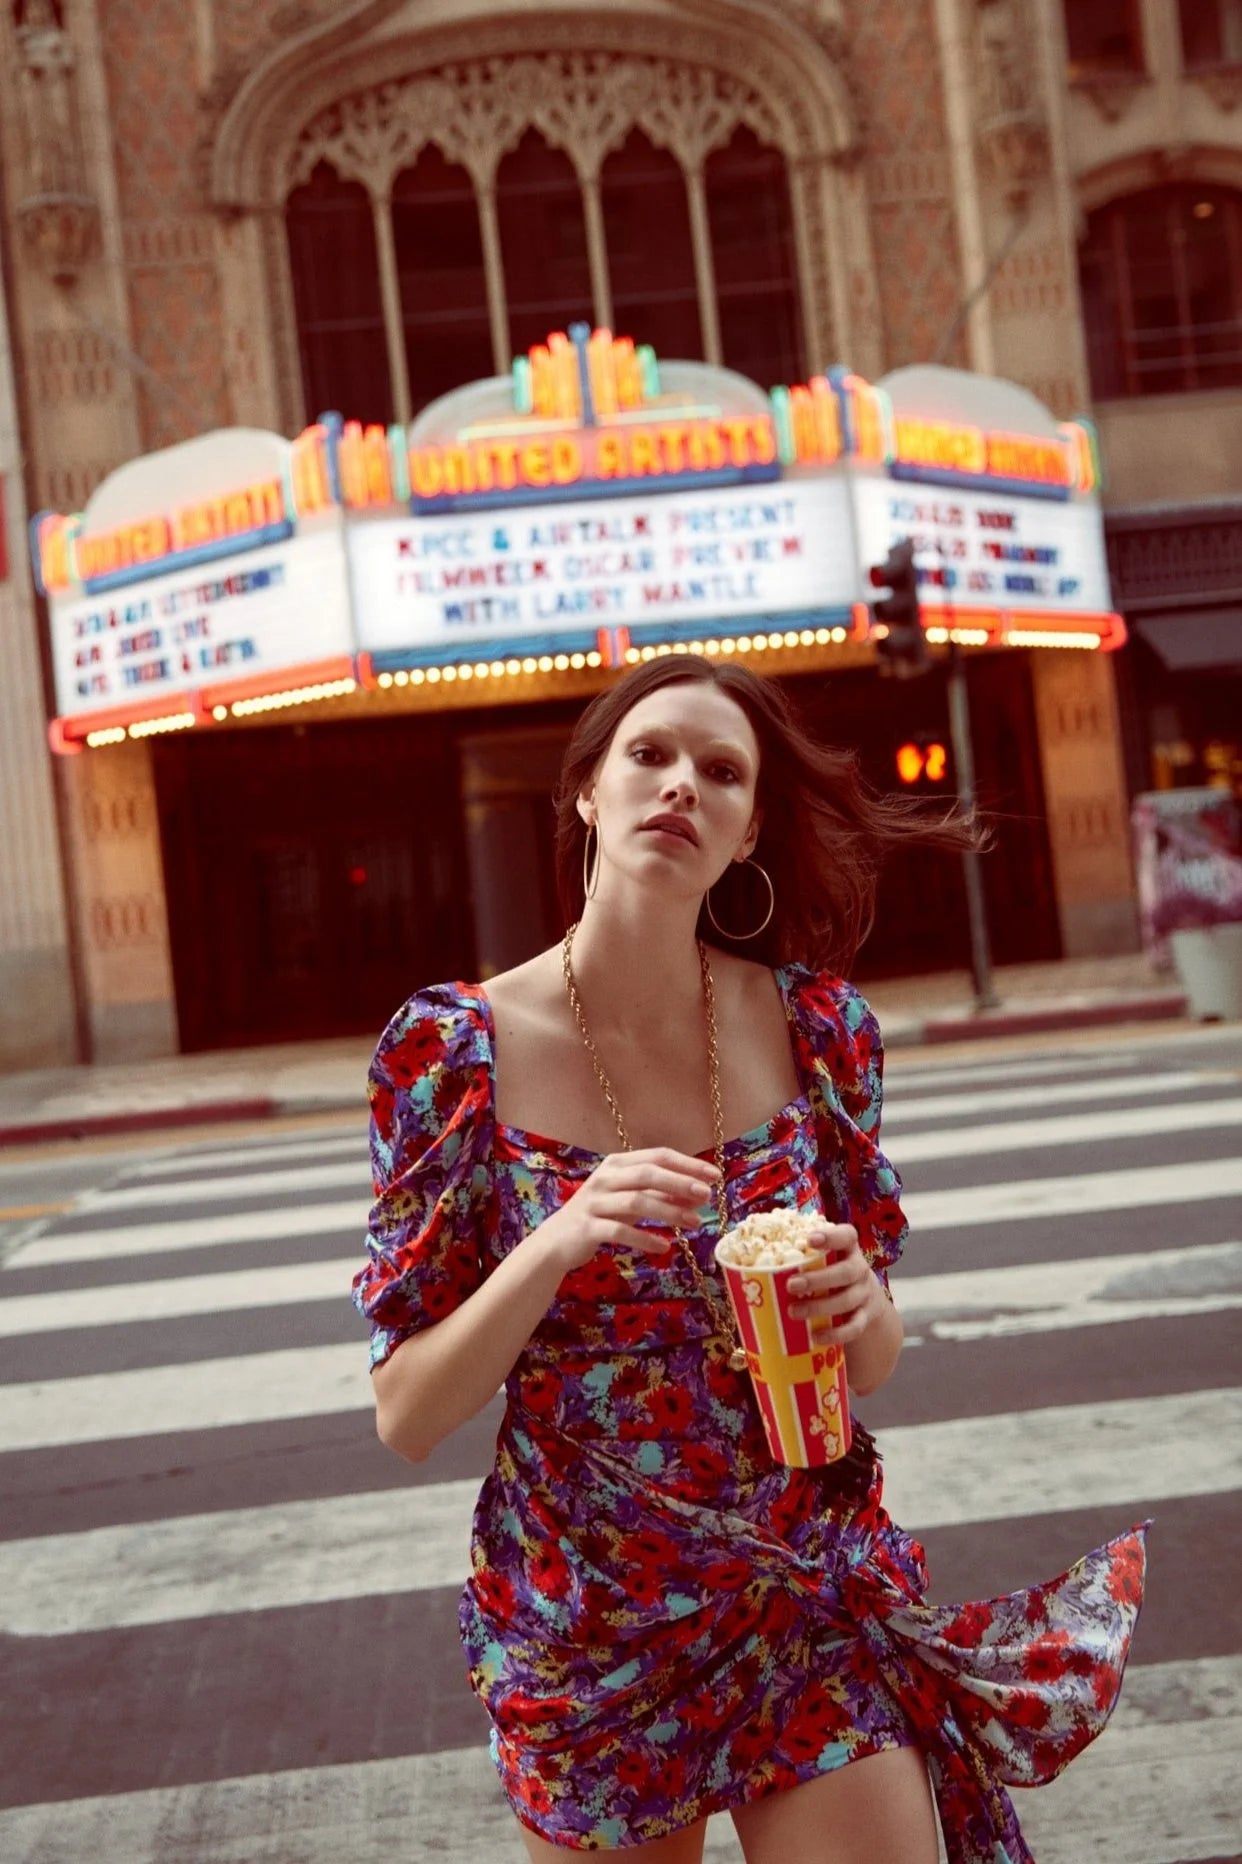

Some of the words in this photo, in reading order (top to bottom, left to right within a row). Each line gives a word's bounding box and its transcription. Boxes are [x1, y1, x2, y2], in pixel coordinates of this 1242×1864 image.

[410, 437, 583, 498] UNITED
[597, 416, 776, 480] ARTISTS
[397, 529, 474, 558] KPCC
[491, 525, 510, 553] &
[669, 499, 795, 535] PRESENT
[564, 551, 655, 582] OSCAR
[443, 595, 521, 624] WITH
